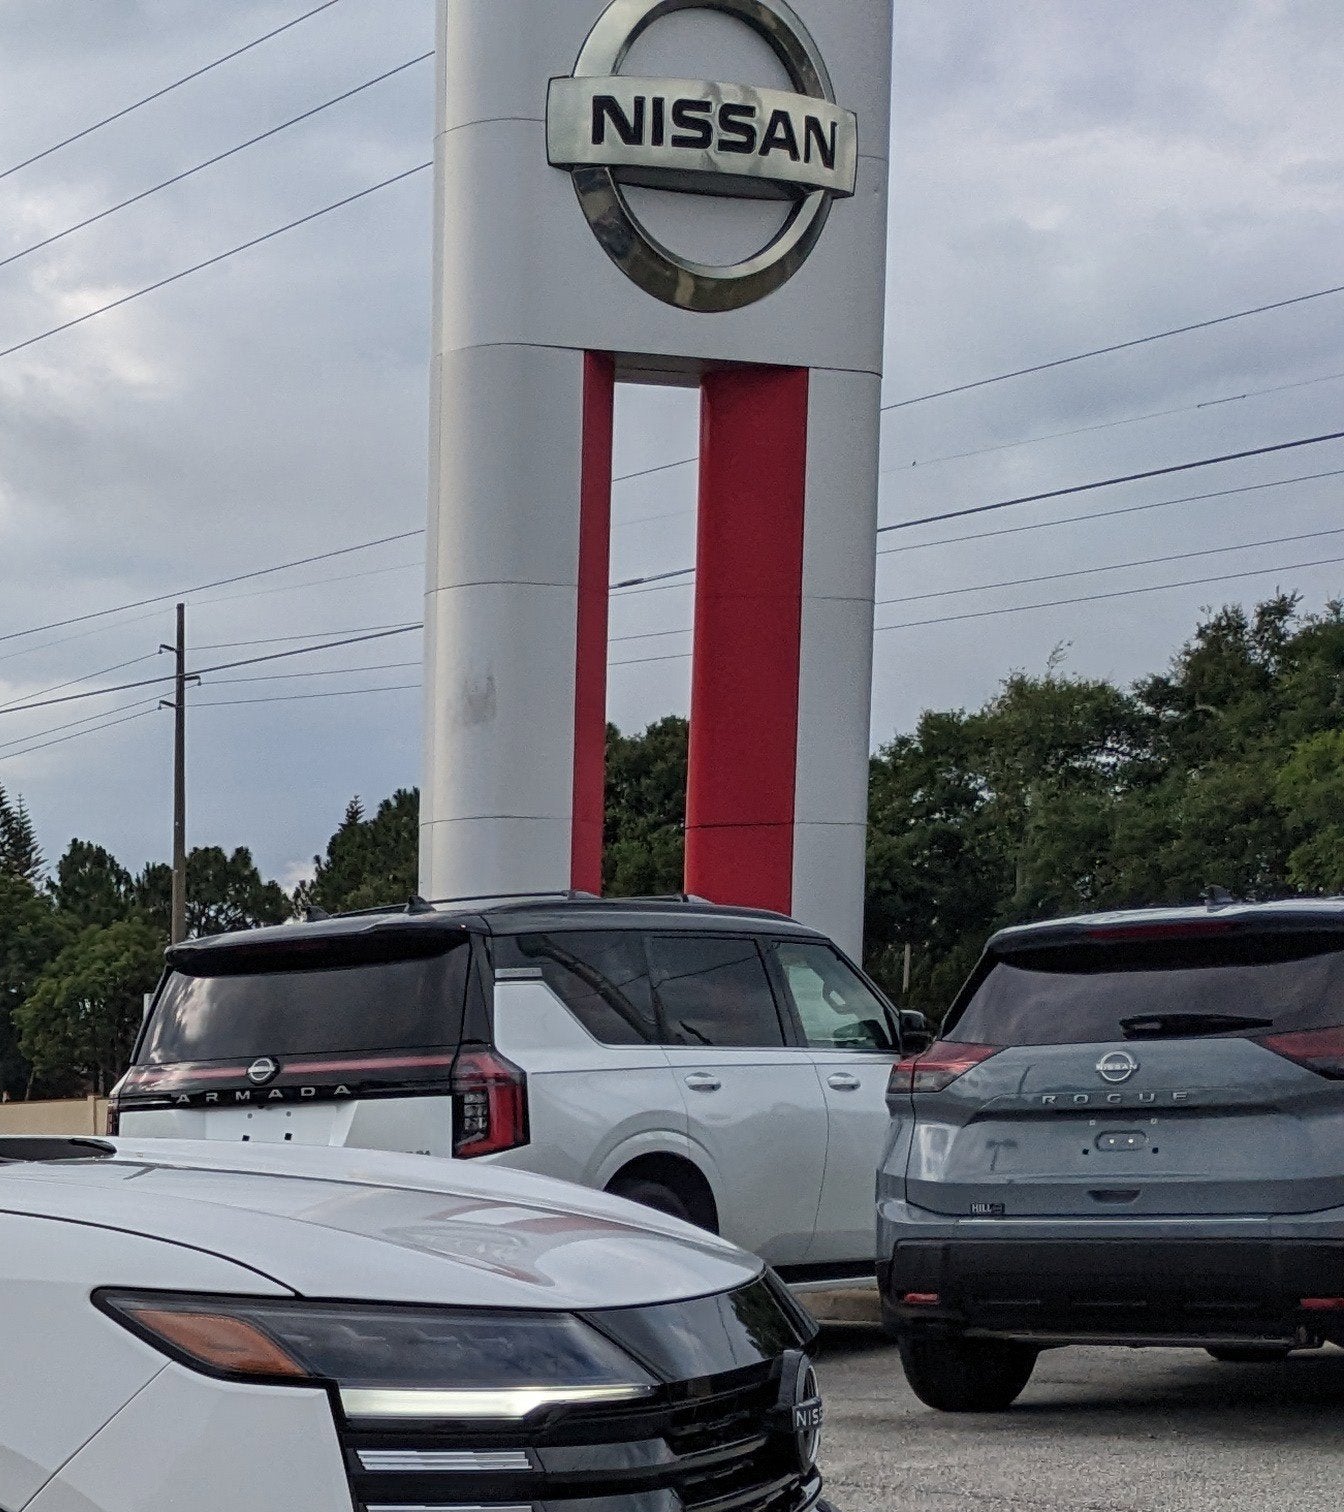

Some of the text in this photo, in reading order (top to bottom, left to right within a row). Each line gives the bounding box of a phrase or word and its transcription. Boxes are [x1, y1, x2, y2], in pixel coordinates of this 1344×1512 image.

[591, 95, 838, 170] NISSAN
[176, 1085, 351, 1103] ARMADA
[1042, 1091, 1188, 1104] ROGUE
[971, 1203, 992, 1213] HILL
[796, 1408, 823, 1428] NIS
